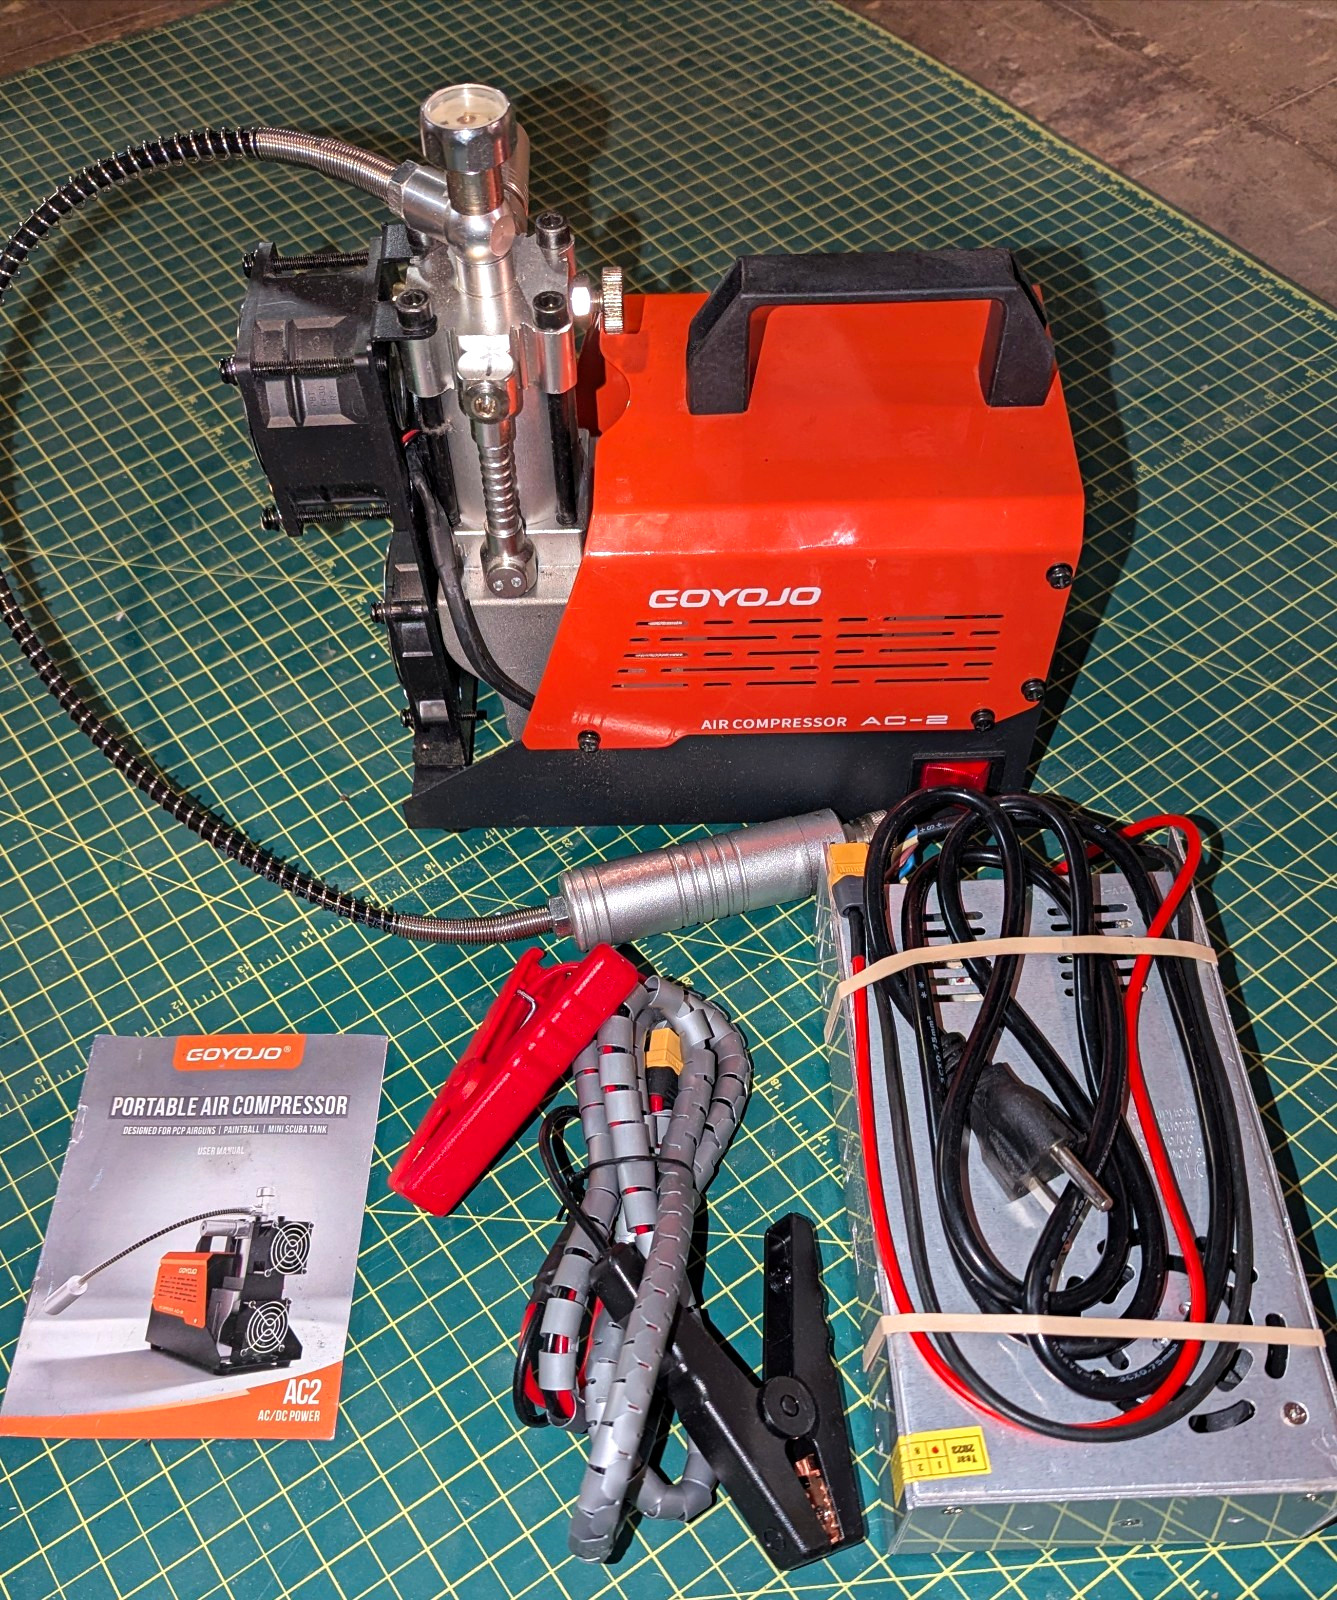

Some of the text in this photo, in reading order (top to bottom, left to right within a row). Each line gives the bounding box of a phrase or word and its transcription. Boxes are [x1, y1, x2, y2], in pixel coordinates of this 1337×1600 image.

[649, 587, 822, 609] GOYOJO
[701, 715, 949, 730] AIR COMPRESSOR AC-2
[423, 861, 437, 872] 16
[301, 928, 314, 938] 14
[237, 963, 250, 974] 13
[110, 1095, 348, 1116] PORTABLE AIR COMPRESSOR
[122, 1124, 328, 1135] DESIGNED FOR PCP AIRGUNS PAINTBALL MINI SCUBA TANK
[197, 1146, 245, 1156] USER MANUAL
[283, 1379, 322, 1405] AC2
[257, 1410, 321, 1422] AC/DC POWER
